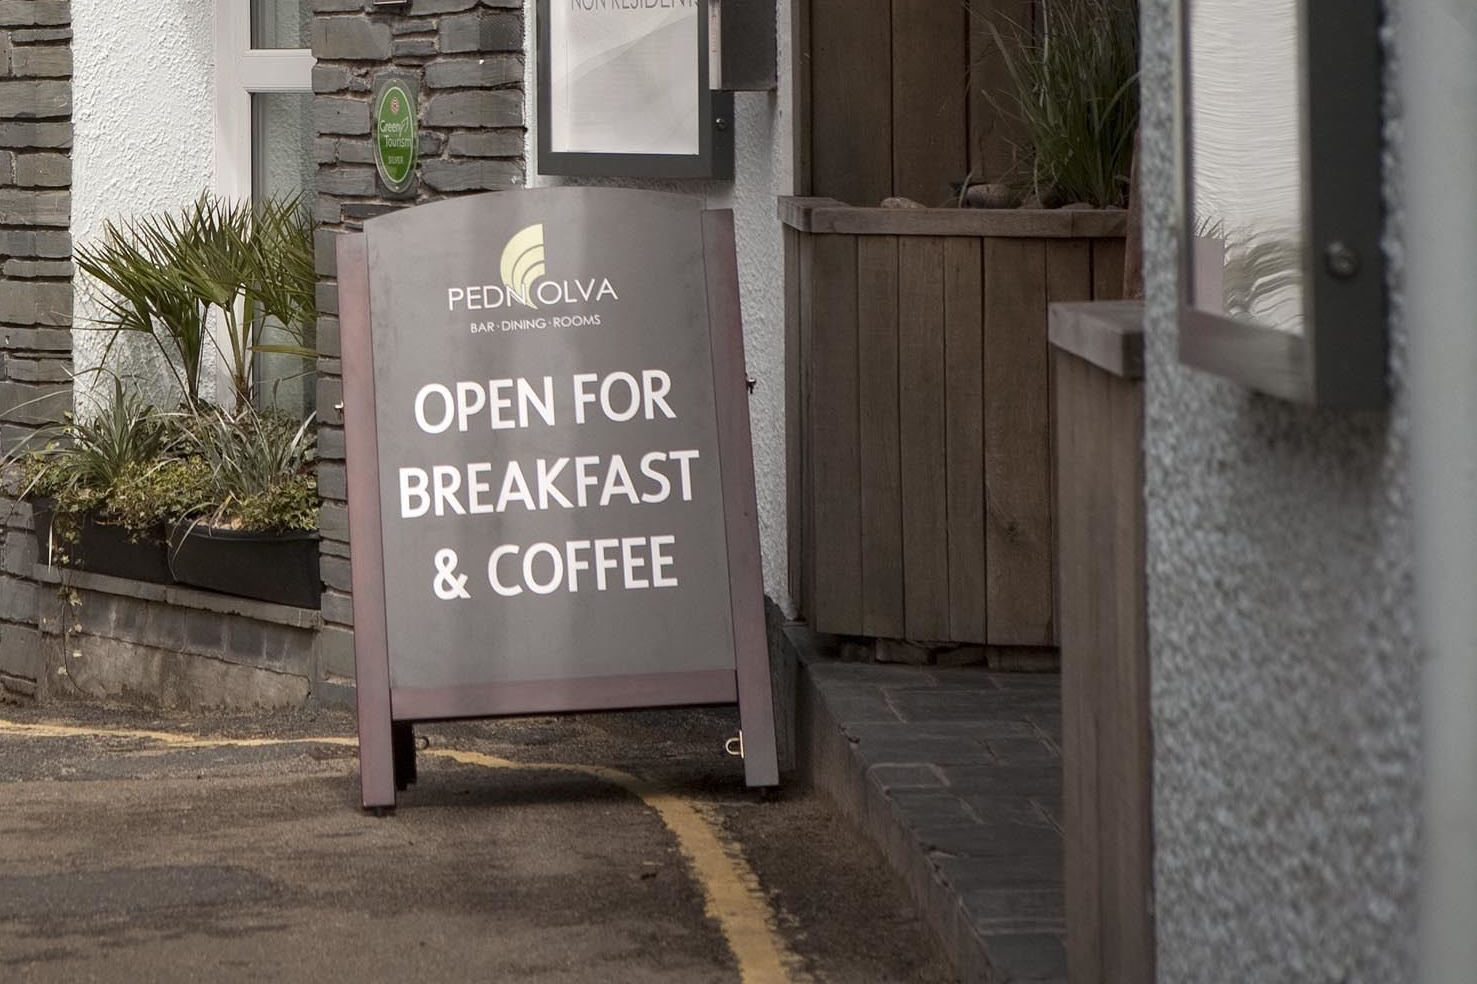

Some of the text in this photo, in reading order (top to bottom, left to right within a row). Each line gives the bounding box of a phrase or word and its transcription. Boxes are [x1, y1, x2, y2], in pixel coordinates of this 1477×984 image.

[380, 119, 401, 133] Green
[448, 278, 619, 311] PEDN OLVA
[470, 315, 601, 333] BAR DINING ROOMS
[414, 369, 677, 434] OPEN FOR
[399, 449, 700, 519] BREAKFAST
[433, 535, 678, 600] & COFFEE
